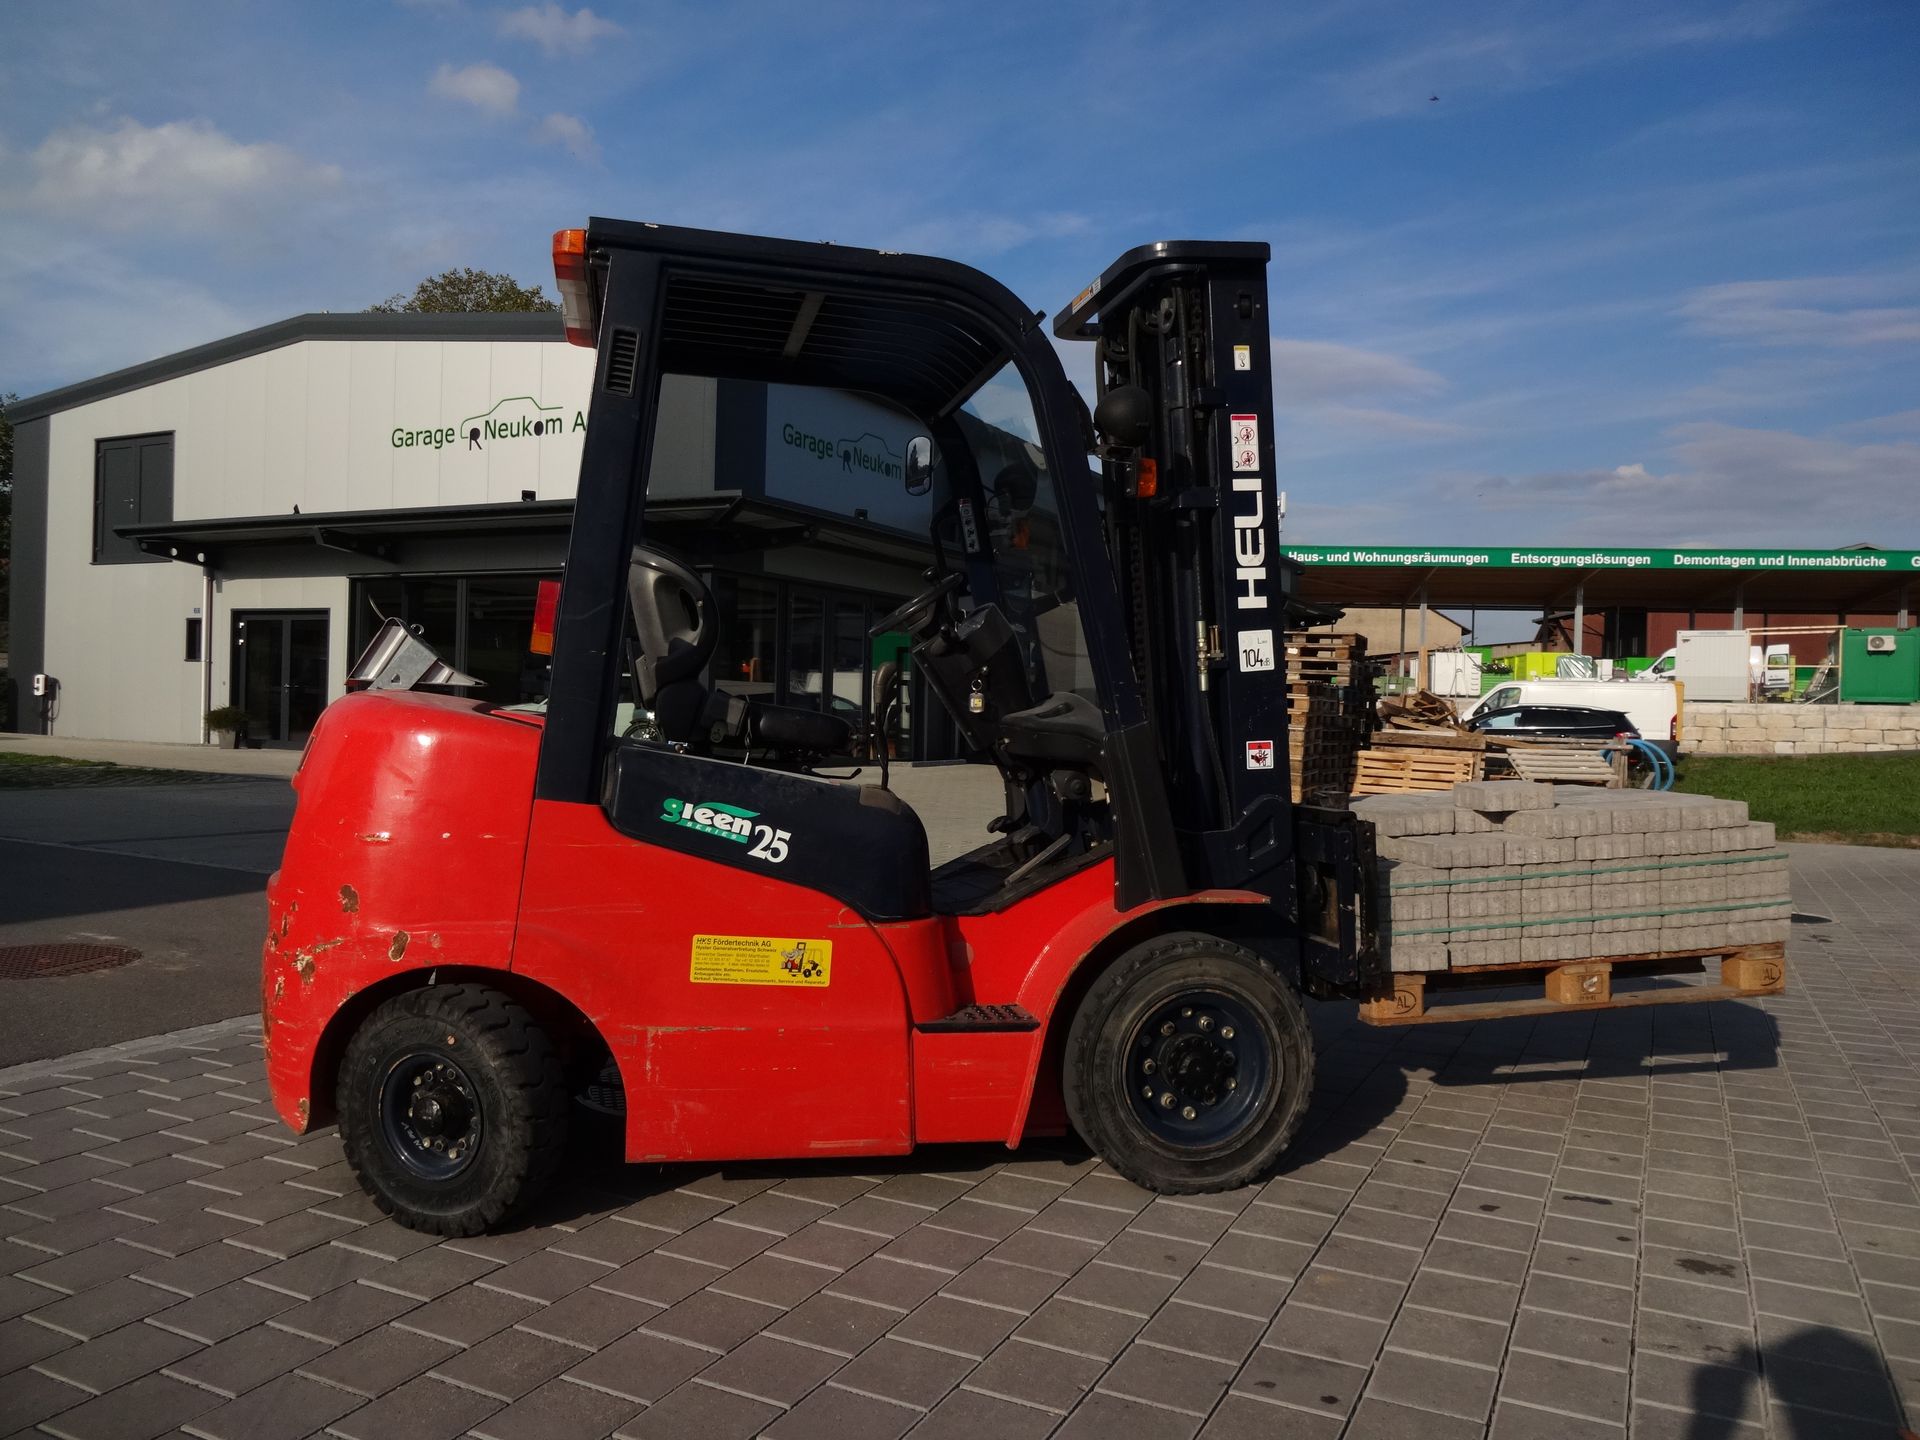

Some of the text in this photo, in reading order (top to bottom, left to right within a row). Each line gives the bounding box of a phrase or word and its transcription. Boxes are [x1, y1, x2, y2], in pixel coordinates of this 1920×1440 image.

[391, 427, 455, 450] Garage
[484, 415, 563, 441] Neukom
[783, 424, 834, 460] Garage
[853, 447, 902, 481] Neukom
[1232, 478, 1268, 609] HELI
[1288, 551, 1489, 565] Haus- und Wohnungsräumungen
[1511, 553, 1651, 567] Entsorgungslösungen
[1674, 554, 1887, 568] Demontagen und Innenabbrüche
[1243, 648, 1263, 668] 104
[686, 821, 738, 840] SERIES
[747, 825, 792, 863] 25
[696, 937, 772, 948] HKS Fördertechnik AG
